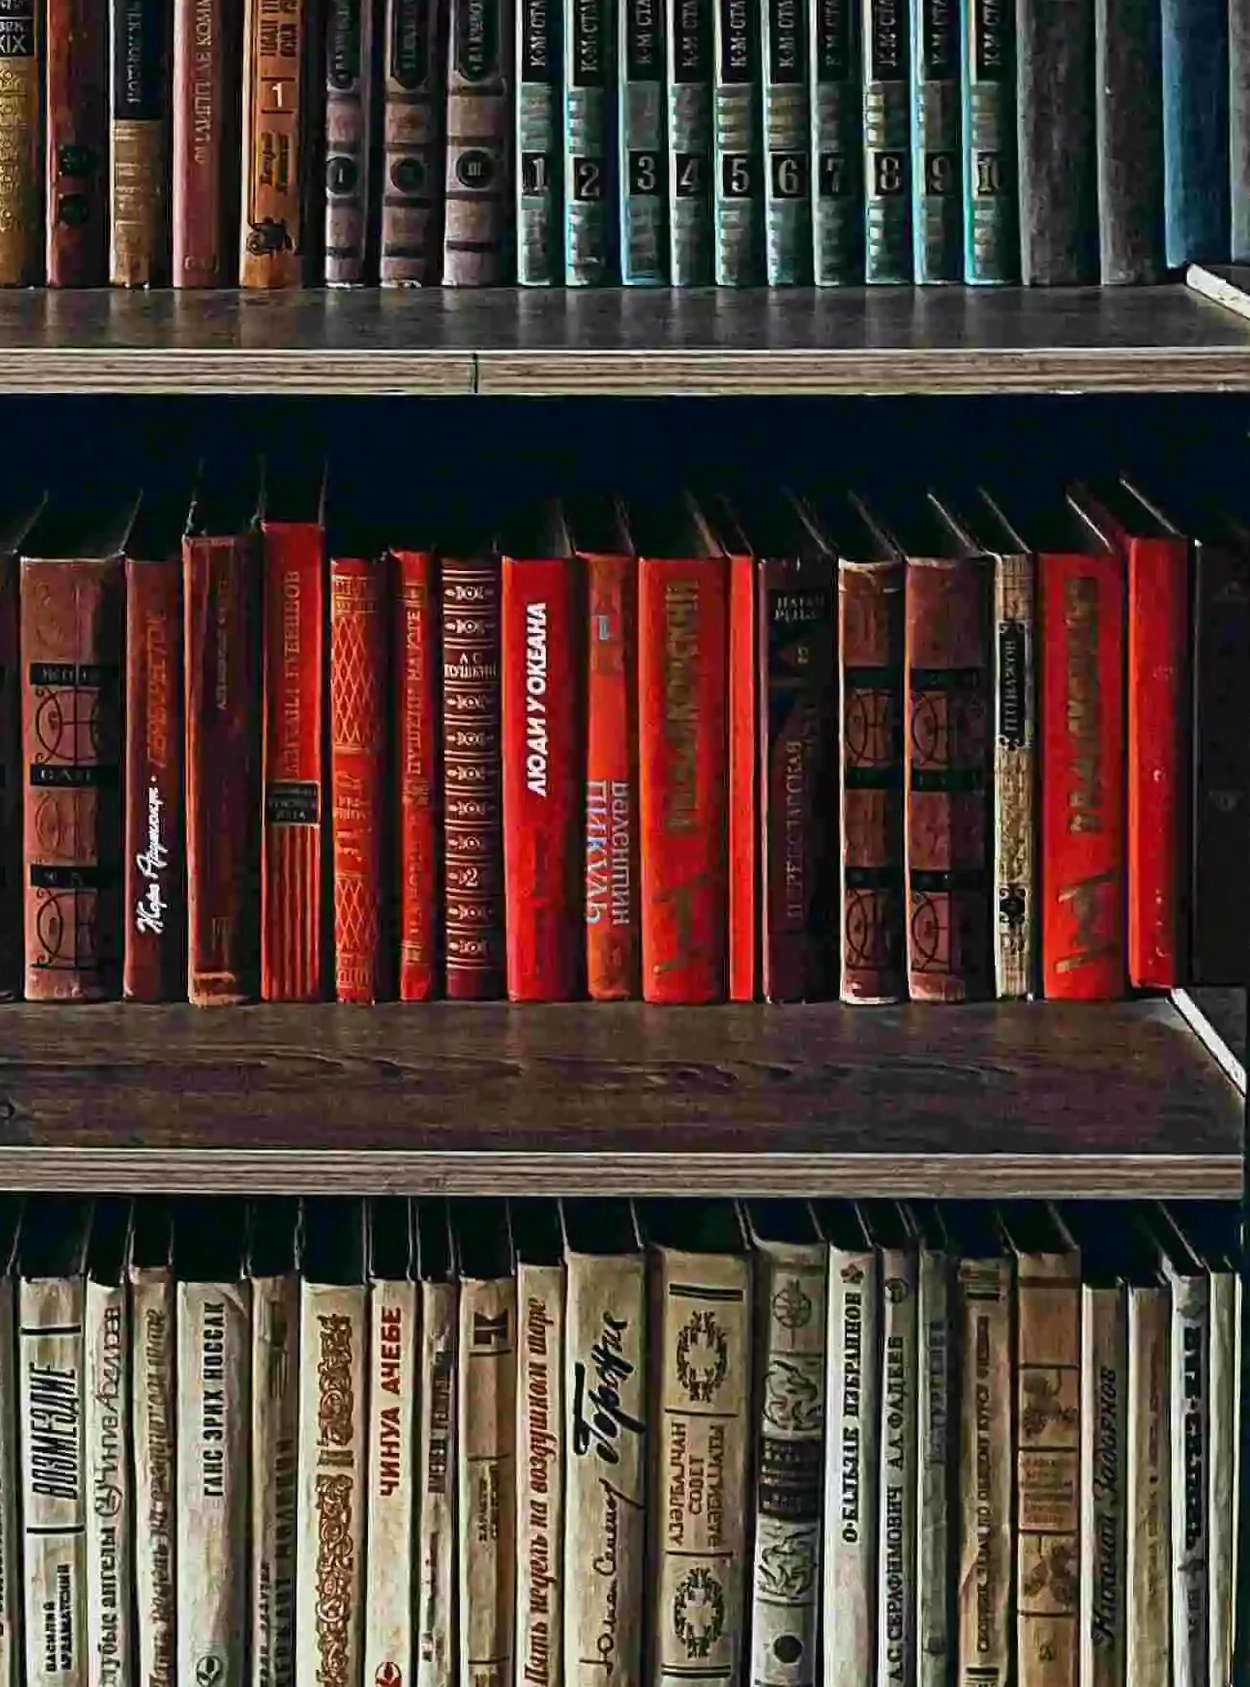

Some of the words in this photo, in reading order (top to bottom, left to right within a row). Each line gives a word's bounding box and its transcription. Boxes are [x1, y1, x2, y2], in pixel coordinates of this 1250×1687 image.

[533, 155, 546, 191] 1
[578, 163, 601, 197] 2
[636, 156, 656, 191] 3
[678, 161, 700, 193] 4
[729, 159, 749, 195] 5
[777, 159, 798, 195] 6
[826, 159, 845, 193] 7
[878, 159, 901, 191] 8
[930, 160, 952, 192] 9
[526, 603, 546, 693] ОКЕАНА
[527, 697, 546, 712] У
[527, 718, 547, 796] ЛЮДИ
[585, 780, 608, 924] ПИКУЛЬ
[203, 1302, 224, 1380] НОССАК
[378, 1308, 401, 1394] АЧЕБЕ
[526, 1299, 552, 1354] шаре
[886, 1337, 905, 1428] ФАДЕЕВ
[29, 1363, 79, 1500] ВОЗМЕЗДИЕ
[203, 1389, 224, 1441] ЭРИХ
[527, 1362, 558, 1494] воздушном
[203, 1450, 224, 1496] ГАНС
[379, 1408, 401, 1496] ЧИНУА
[688, 1457, 704, 1515] СОВЕТ
[528, 1503, 548, 1527] на
[526, 1536, 559, 1614] недель
[886, 1486, 903, 1641] СЕРАФИМОВИЧ
[43, 1602, 58, 1672] ВАСИЛИЙ
[524, 1622, 549, 1686] Пять
